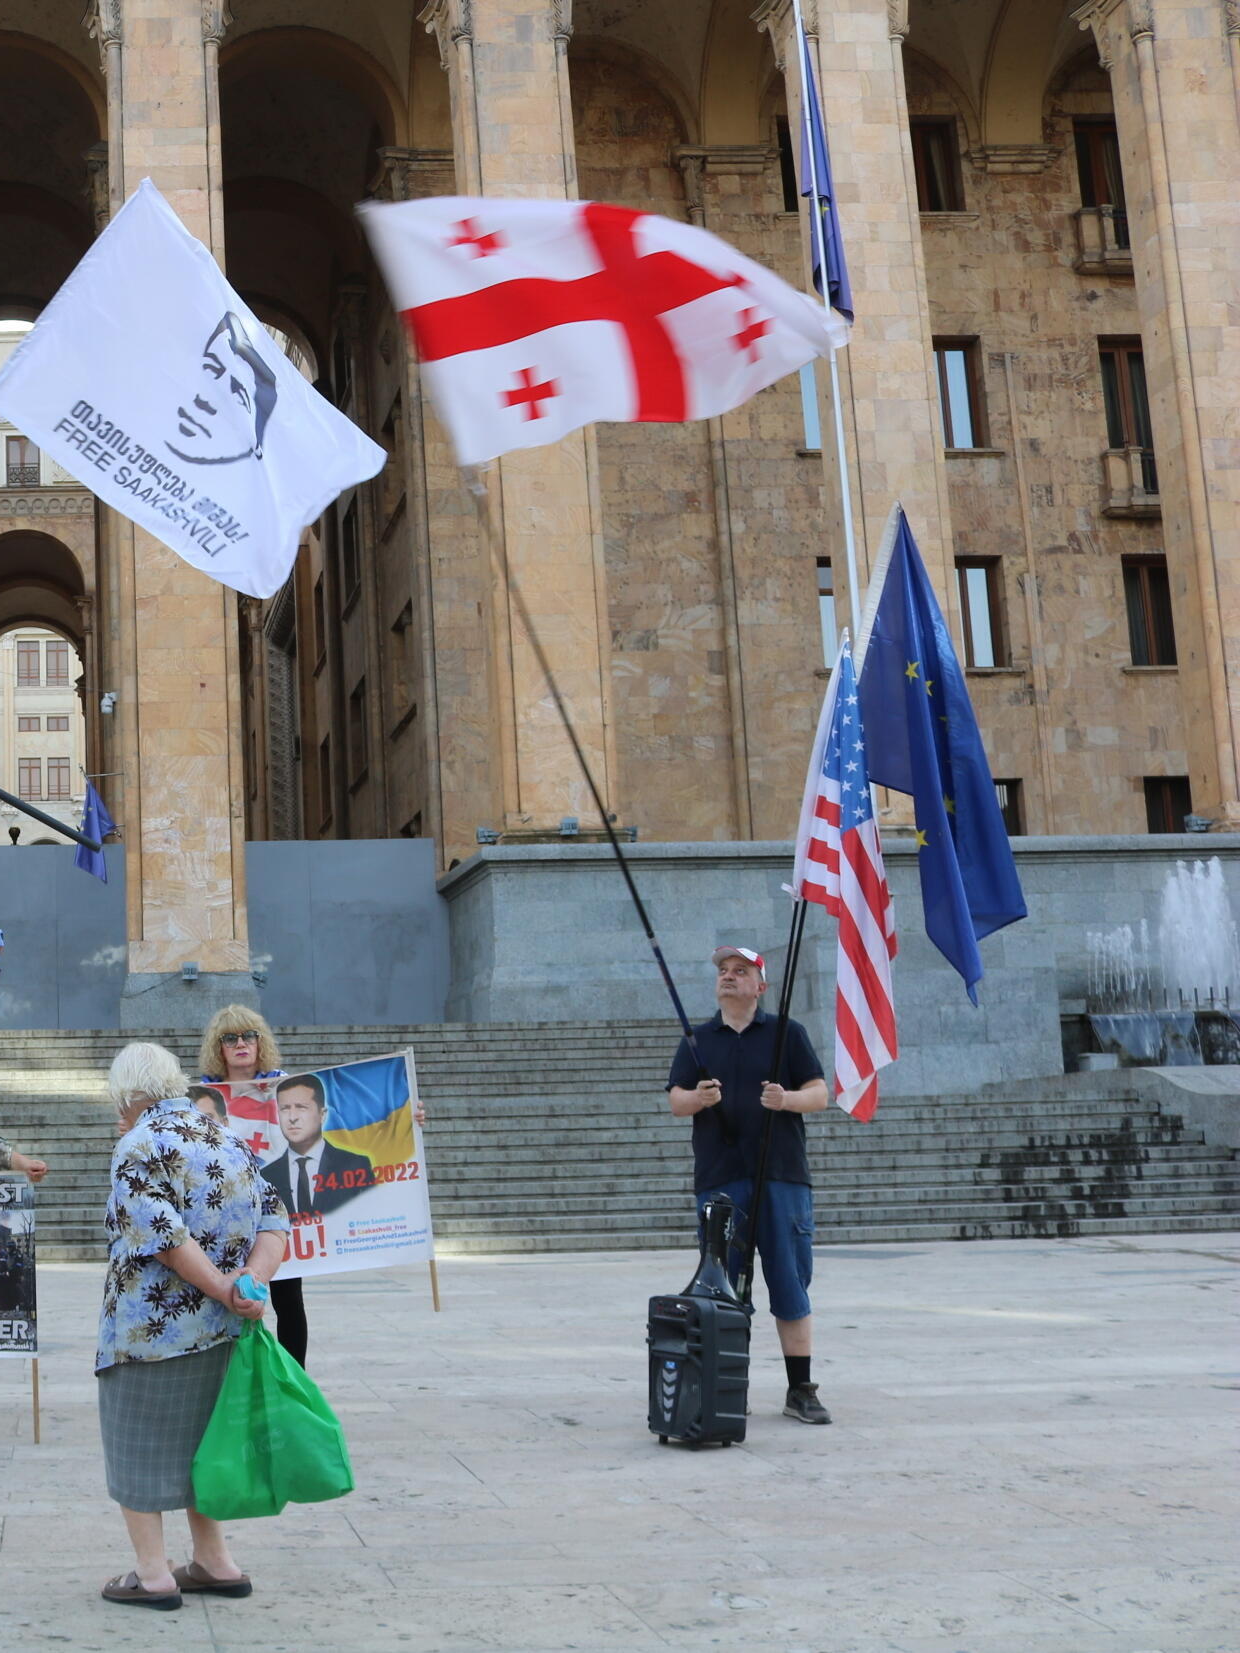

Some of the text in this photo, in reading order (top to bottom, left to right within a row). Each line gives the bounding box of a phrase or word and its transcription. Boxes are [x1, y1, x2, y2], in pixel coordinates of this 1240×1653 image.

[53, 418, 117, 472] FREE
[70, 399, 196, 502] თავისუფლება
[312, 1162, 420, 1193] 24.02.2022
